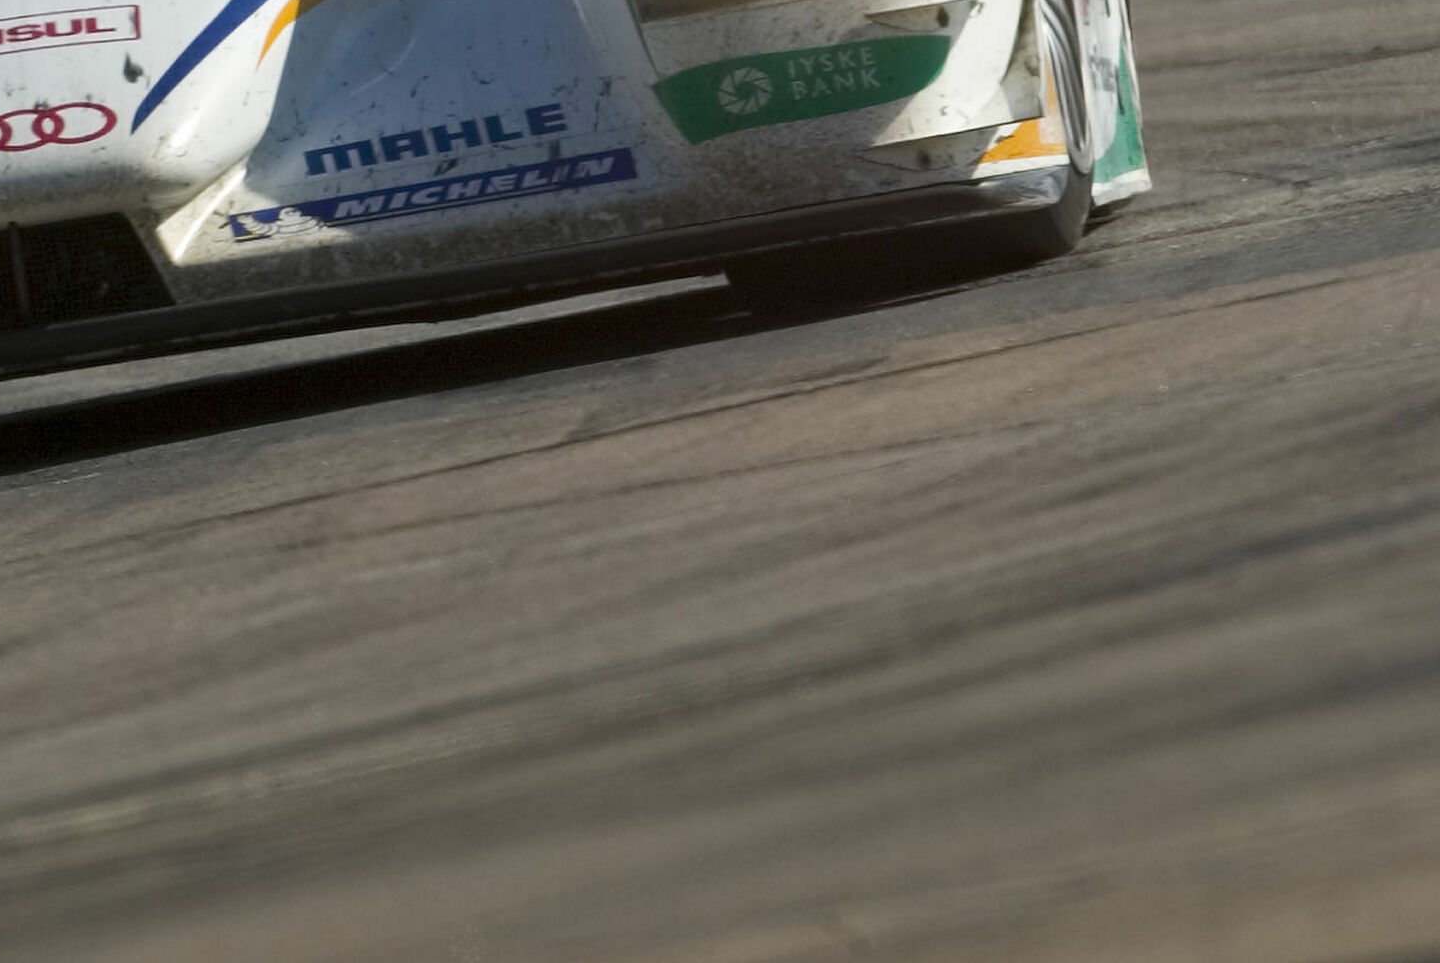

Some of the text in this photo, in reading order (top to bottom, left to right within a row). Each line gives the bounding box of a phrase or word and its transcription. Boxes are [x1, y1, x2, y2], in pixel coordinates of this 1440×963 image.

[788, 48, 876, 78] JYSKE
[791, 68, 881, 101] BANK
[303, 103, 567, 176] MAHLE
[333, 157, 616, 220] MICHELIN
